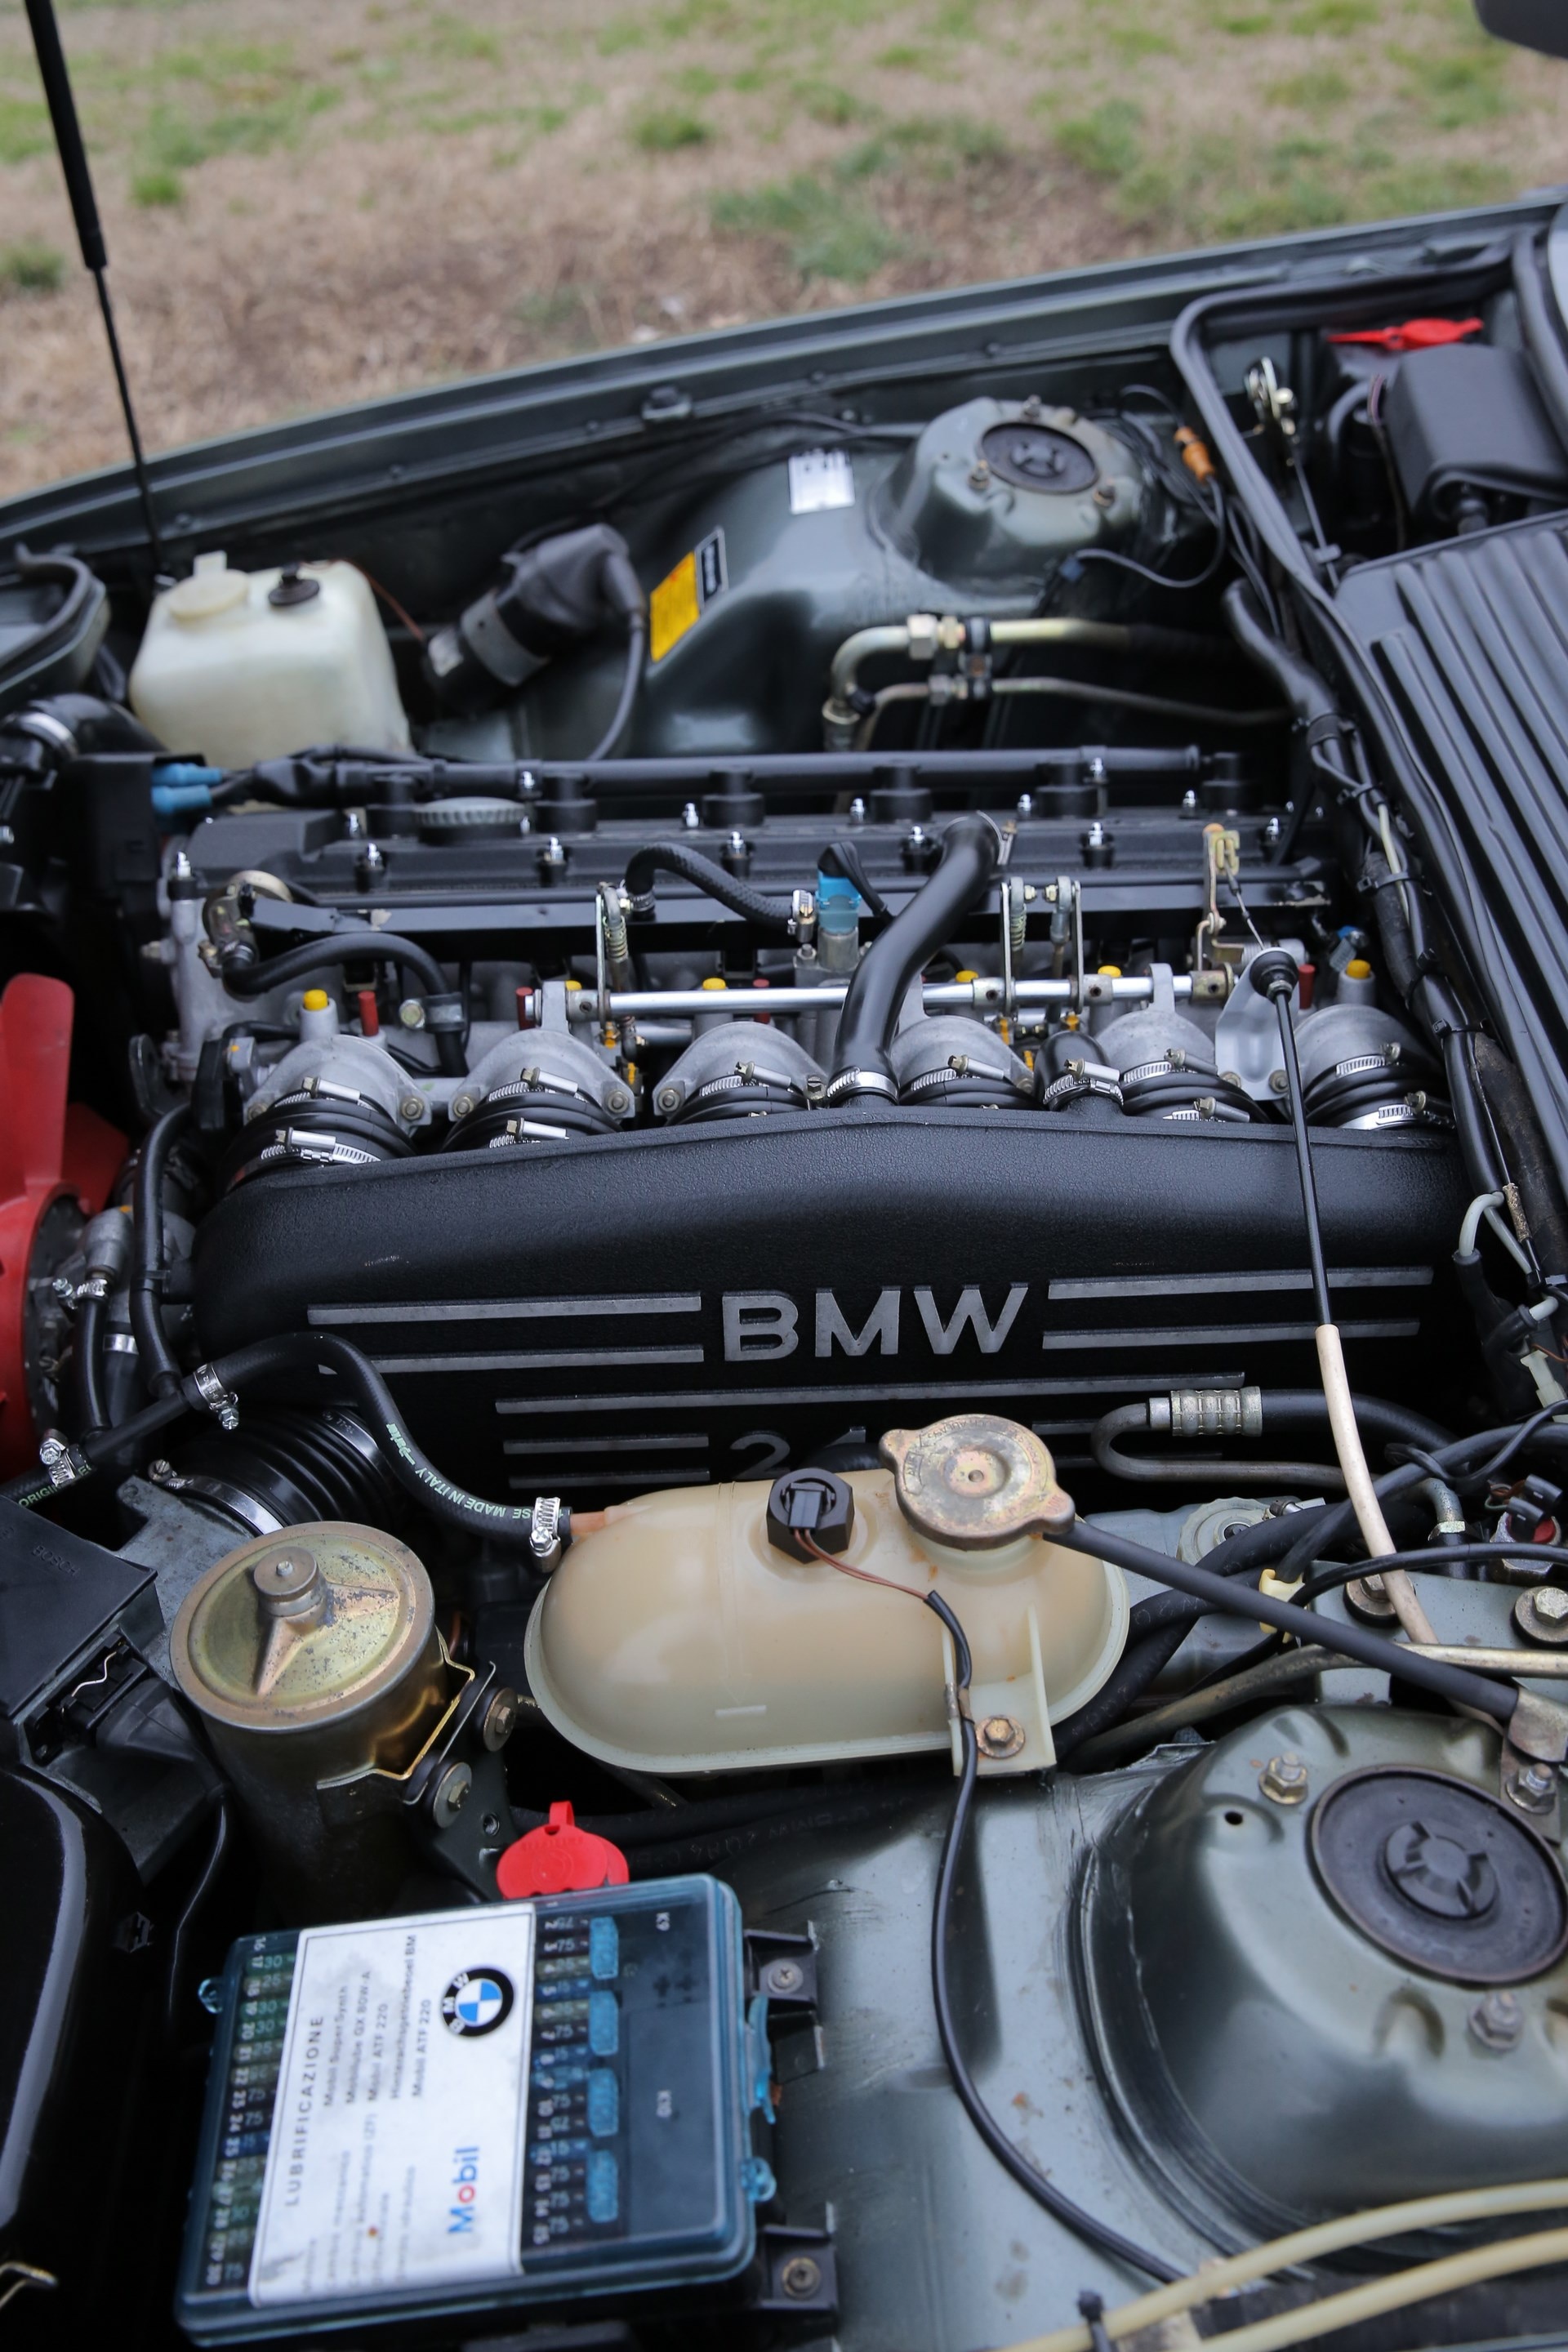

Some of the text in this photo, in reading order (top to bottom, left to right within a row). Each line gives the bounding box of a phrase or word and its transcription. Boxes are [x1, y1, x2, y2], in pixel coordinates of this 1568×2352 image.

[721, 1282, 1029, 1361] BMW
[415, 1468, 451, 1496] ITALY
[448, 1490, 466, 1505] IN
[464, 1498, 506, 1517] MADE
[31, 1544, 81, 1577] BOSCH
[657, 1912, 670, 1931] K9
[442, 1971, 470, 2034] BMW
[368, 2003, 389, 2101] Mobil ATF 220
[412, 1998, 432, 2097] Mobil ATF 220
[285, 2016, 323, 2206] LUBRIFICAZIONE
[324, 2067, 338, 2106] Mobil
[447, 2147, 479, 2234] Mobil
